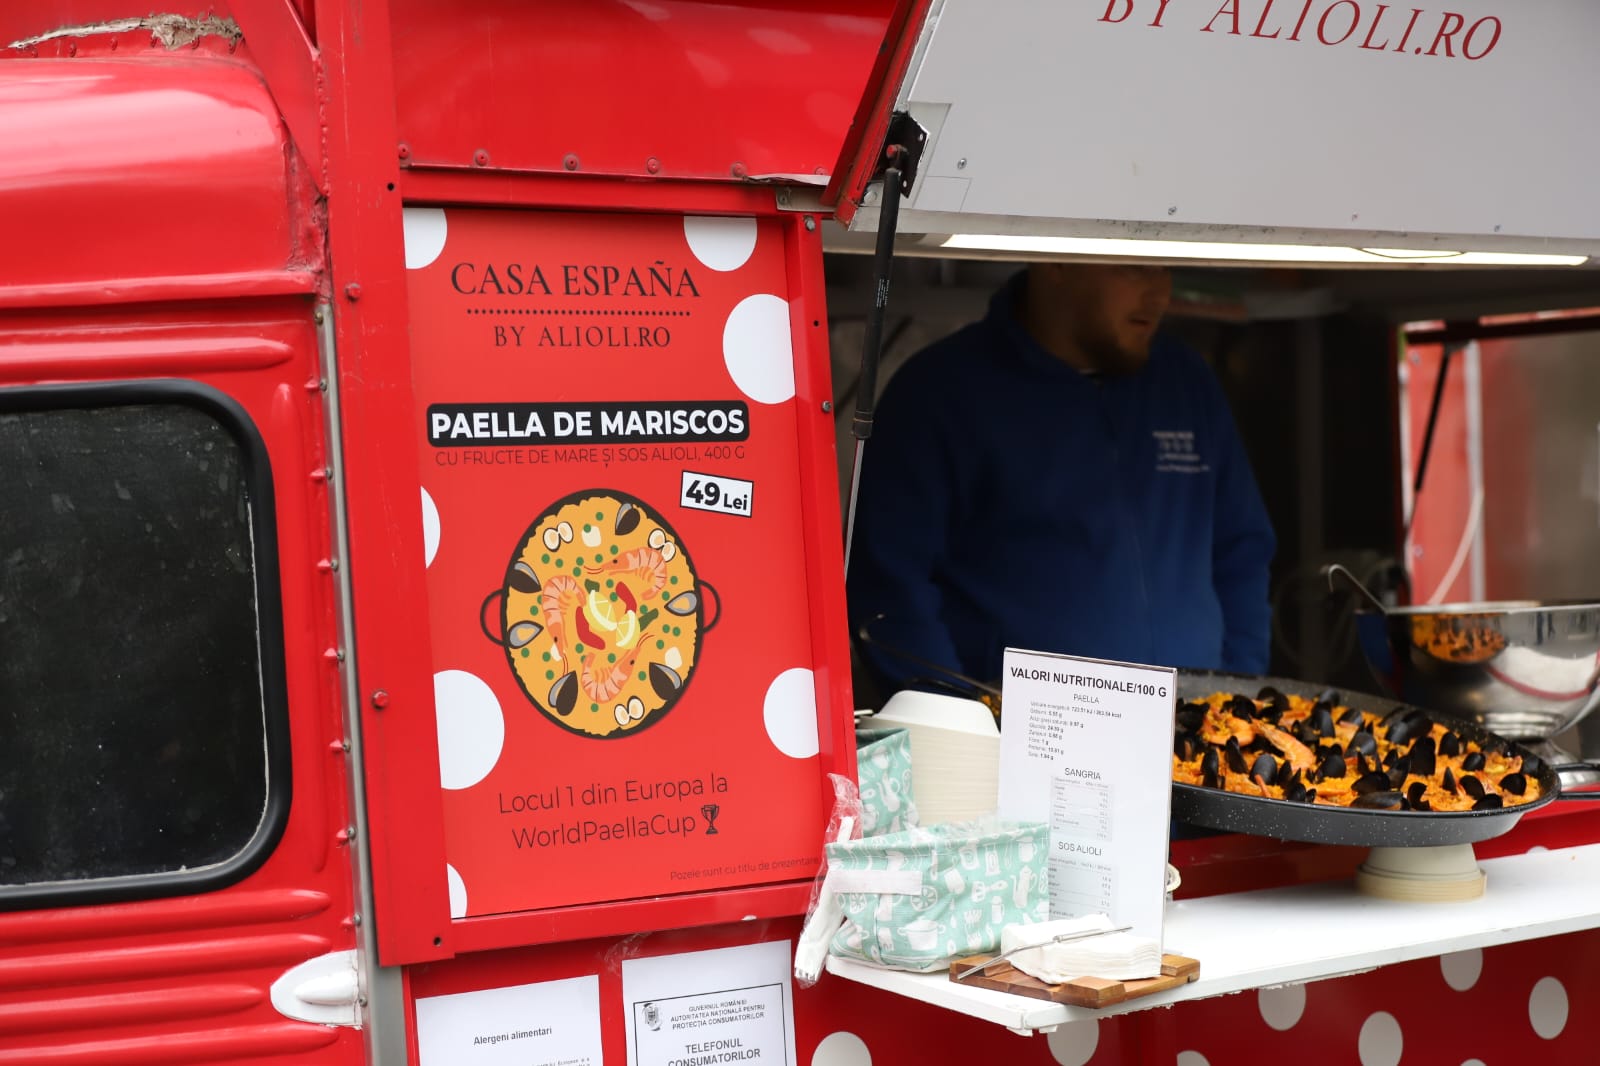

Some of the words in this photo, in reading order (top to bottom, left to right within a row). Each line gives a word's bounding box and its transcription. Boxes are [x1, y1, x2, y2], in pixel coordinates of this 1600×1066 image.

[451, 262, 553, 295] CASA
[563, 261, 701, 297] ESPAÑA
[494, 325, 526, 347] BY
[538, 325, 671, 348] ALIOLI.RO
[431, 411, 546, 439] PAELLA
[554, 411, 593, 437] DE
[600, 409, 745, 436] MARISCOS
[435, 451, 458, 466] CU
[463, 449, 525, 465] FRUCTE
[528, 449, 550, 464] DE
[554, 448, 598, 463] MARE
[619, 447, 648, 462] SOS
[651, 446, 701, 462] ALIOLI,
[704, 445, 731, 460] 400
[735, 445, 745, 459] G
[685, 479, 720, 506] 49
[723, 493, 748, 510] Lei
[1011, 666, 1050, 682] VALORI
[1053, 672, 1155, 696] NUTRITIONALE/100
[1158, 686, 1167, 698] G
[1073, 693, 1100, 705] PAELLA
[1064, 767, 1101, 780] SANGRIA
[498, 786, 561, 814] Locul
[565, 786, 574, 807] 1
[581, 783, 617, 806] din
[625, 776, 703, 803] Europa
[711, 773, 728, 793] la
[511, 812, 696, 850] WorldPaellaCup
[1058, 841, 1075, 852] SOS
[1076, 843, 1102, 856] ALIOLI
[702, 867, 722, 877] sunt
[725, 865, 736, 874] cu
[758, 861, 769, 871] de
[670, 1011, 710, 1022] AUTORITATEA
[743, 1004, 765, 1012] PENTRU
[688, 1002, 719, 1012] GUVERNUL
[708, 1011, 765, 1026] CONSUMATORILOR
[473, 1032, 509, 1045] Alergeni
[511, 1026, 552, 1040] alimentari
[685, 1038, 743, 1054] TELEFONUL
[668, 1048, 761, 1066] CONSUMATORILOR
